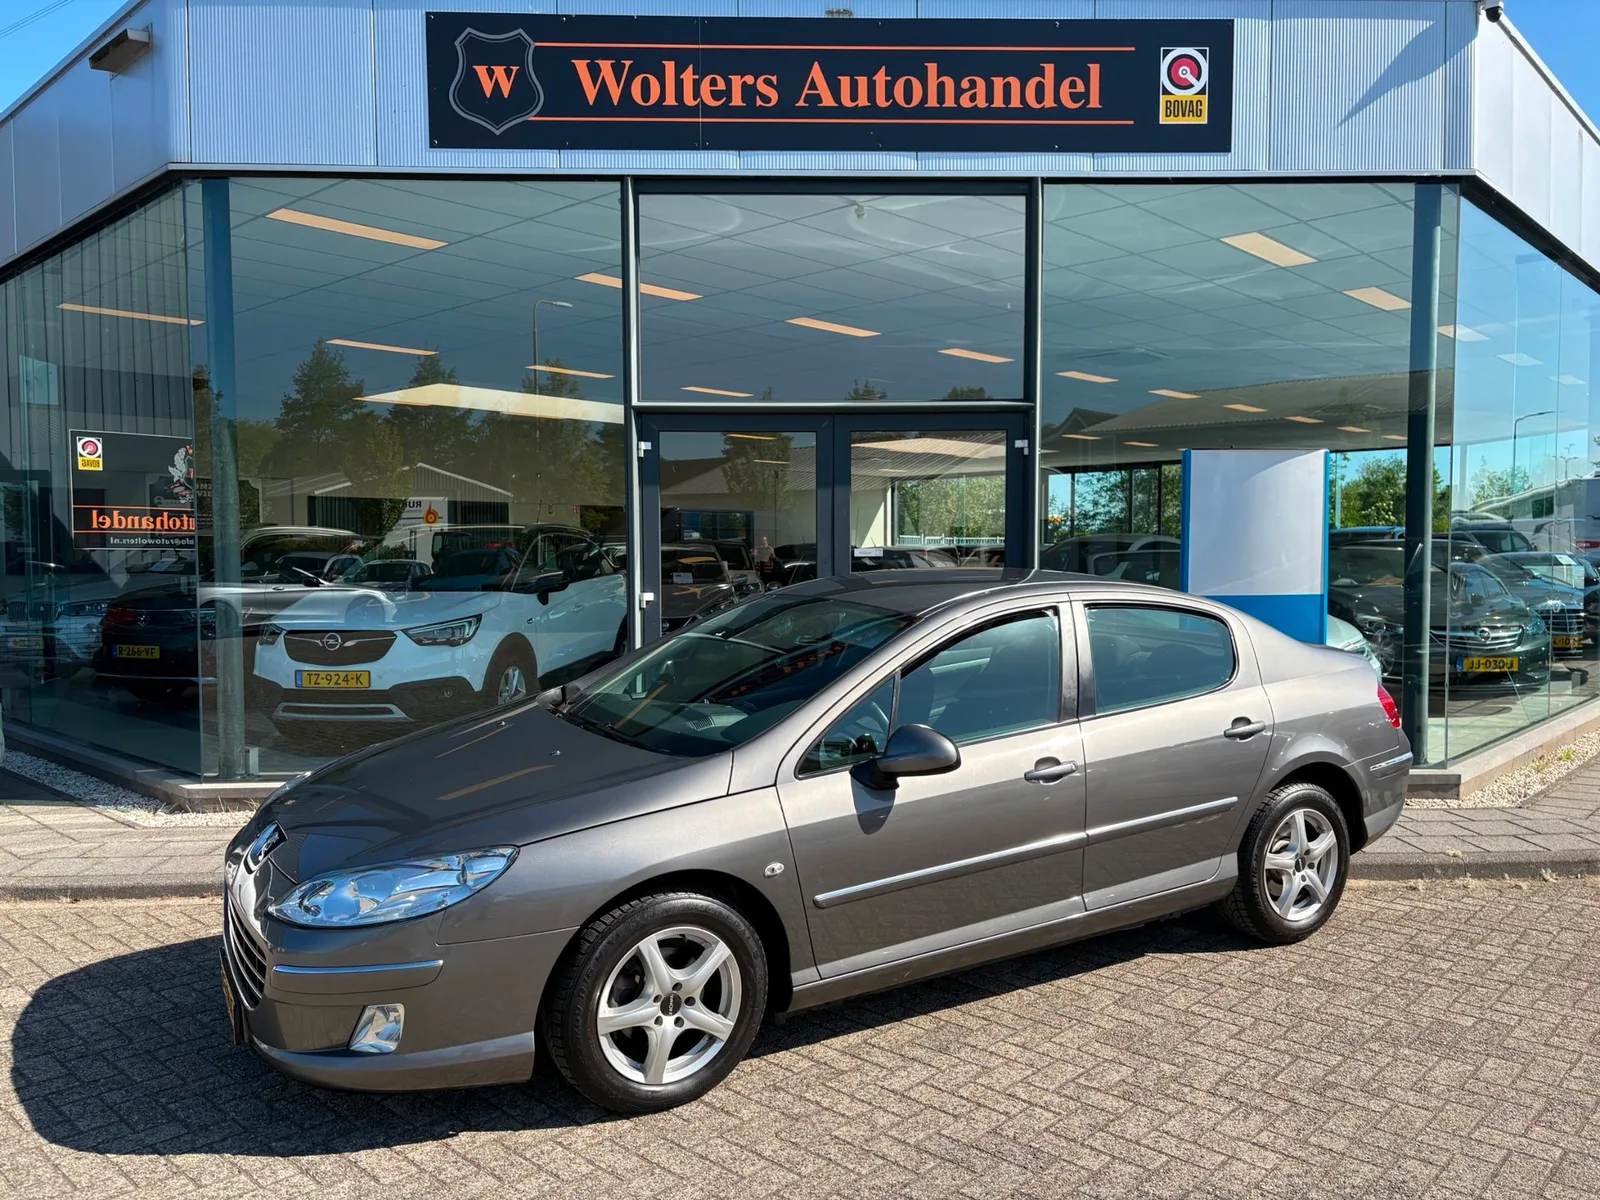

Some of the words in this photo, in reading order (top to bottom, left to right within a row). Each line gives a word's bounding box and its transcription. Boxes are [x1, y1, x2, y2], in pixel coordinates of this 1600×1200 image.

[472, 65, 520, 99] W
[571, 59, 779, 107] Wolters
[795, 60, 1102, 109] Autohandel
[1164, 99, 1203, 118] BOVAG
[306, 673, 364, 686] TZ-924-K
